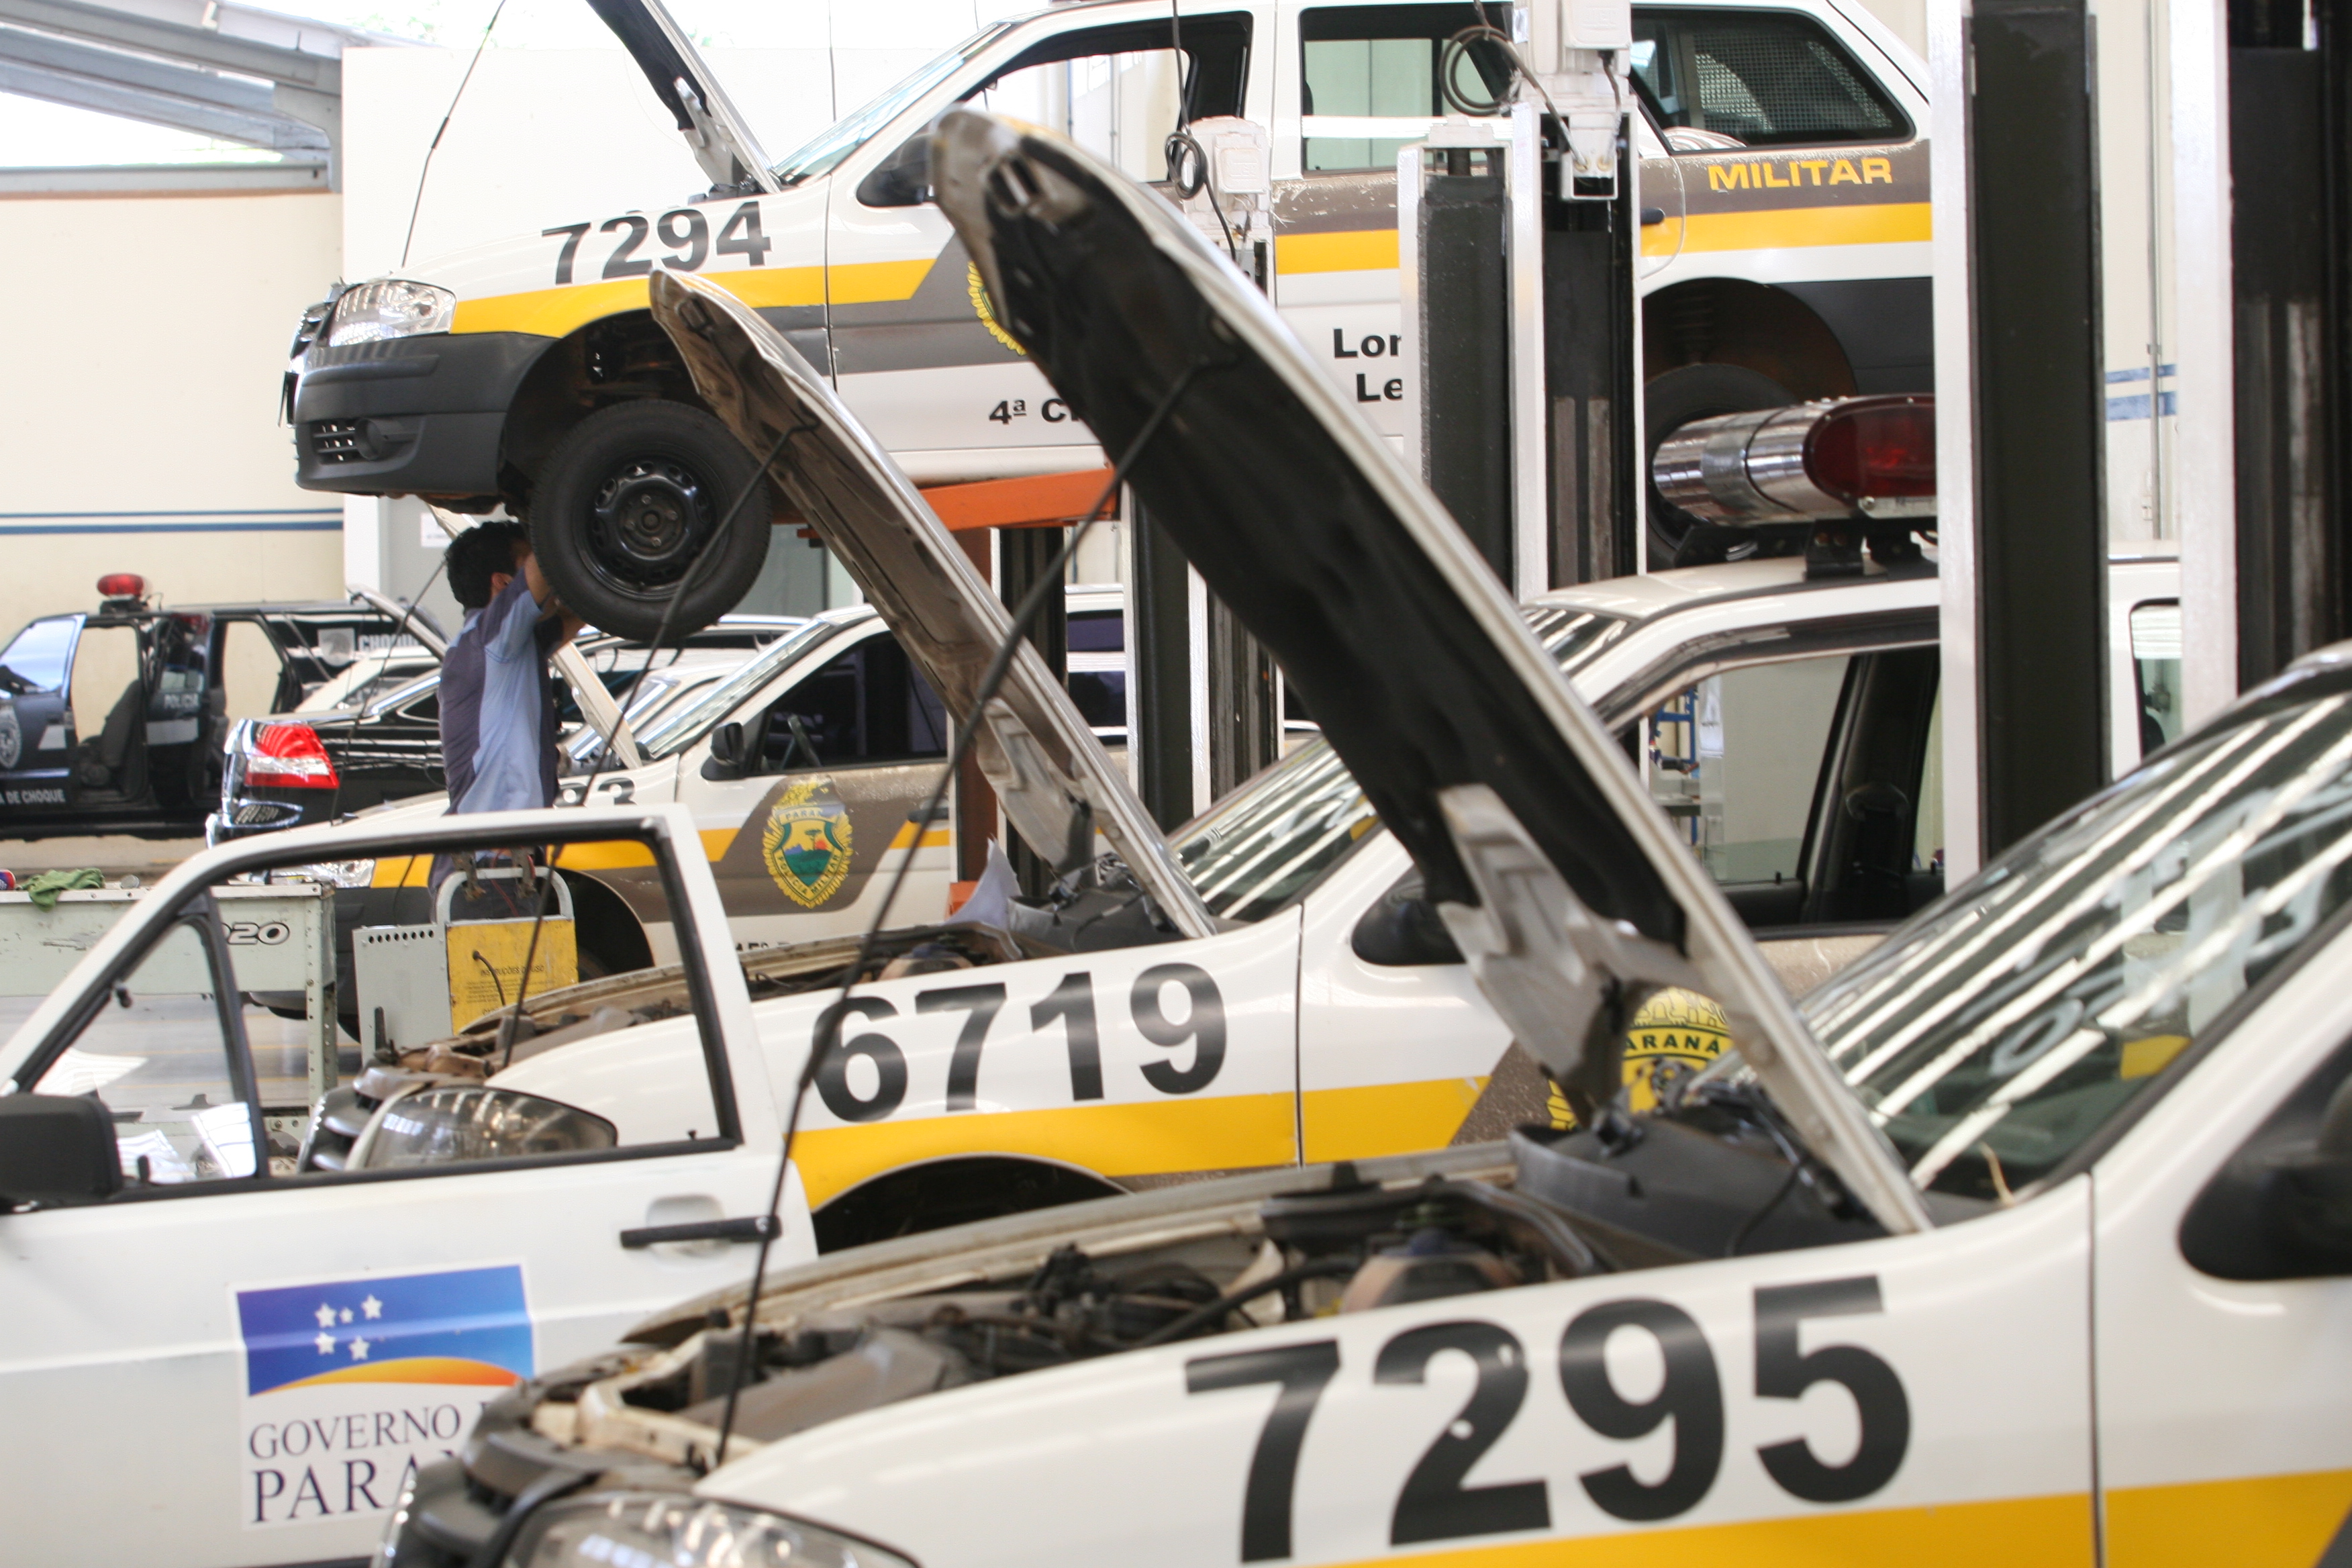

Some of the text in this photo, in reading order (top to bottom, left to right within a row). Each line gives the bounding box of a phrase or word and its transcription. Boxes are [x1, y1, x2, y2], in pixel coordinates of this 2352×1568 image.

[1708, 157, 1894, 191] MILITAR
[541, 201, 773, 286] 7294
[21, 788, 66, 804] CHOQUE
[222, 922, 290, 945] 20
[812, 963, 1227, 1122] 6719
[1626, 1034, 1720, 1055] ARANÁ
[249, 1404, 462, 1461] GOVERNO
[1185, 1274, 1910, 1564] 7295
